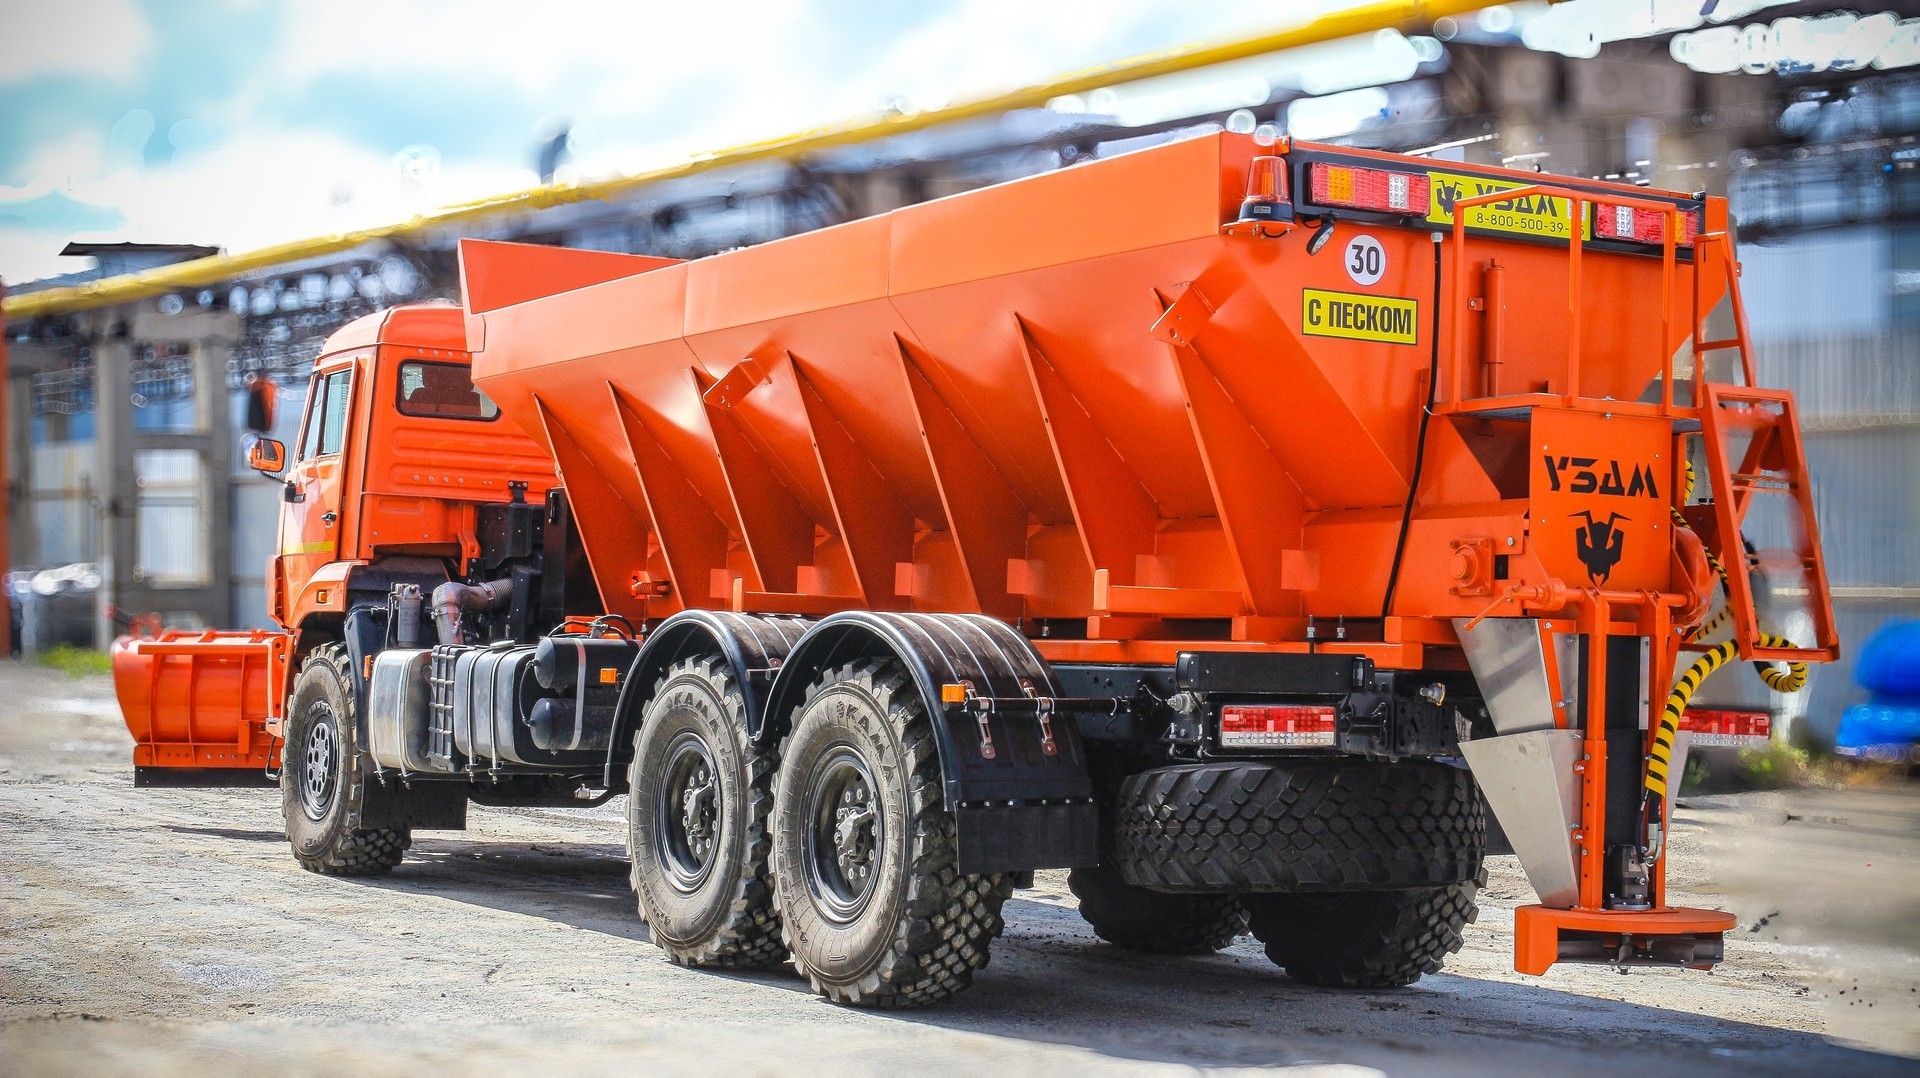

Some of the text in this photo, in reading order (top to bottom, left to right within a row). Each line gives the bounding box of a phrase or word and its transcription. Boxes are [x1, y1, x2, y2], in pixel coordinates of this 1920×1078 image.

[1351, 244, 1380, 275] 30
[1308, 299, 1412, 334] С ПЕСКОМ
[1543, 455, 1659, 498] УЗДМ
